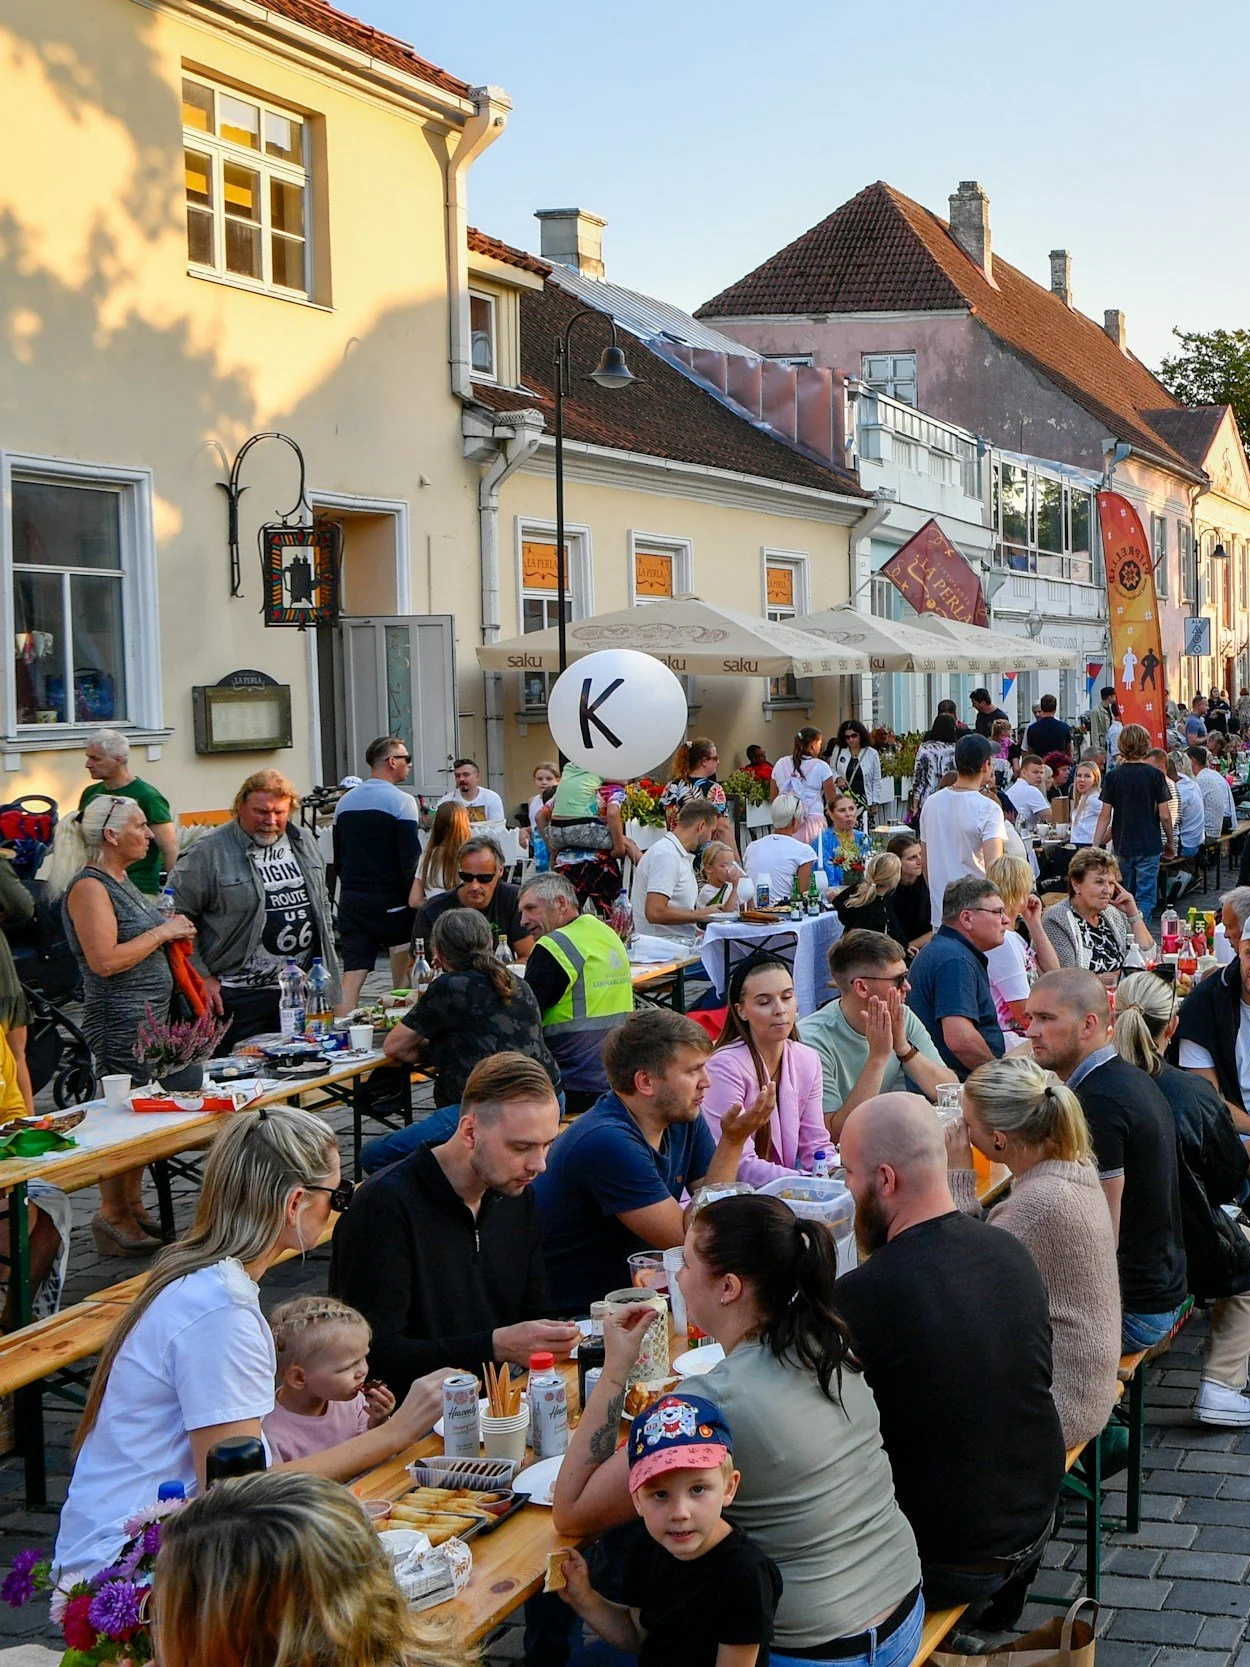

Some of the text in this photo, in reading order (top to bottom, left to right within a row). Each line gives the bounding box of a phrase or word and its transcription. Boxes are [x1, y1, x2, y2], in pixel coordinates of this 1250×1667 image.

[920, 558, 972, 623] LA PERLA
[508, 653, 543, 668] saku
[661, 655, 686, 670] aku
[723, 657, 758, 672] saku
[580, 678, 625, 749] K
[270, 889, 309, 907] ROUTE
[285, 910, 307, 921] US
[276, 921, 313, 952] 66
[448, 1404, 477, 1420] Heavenly
